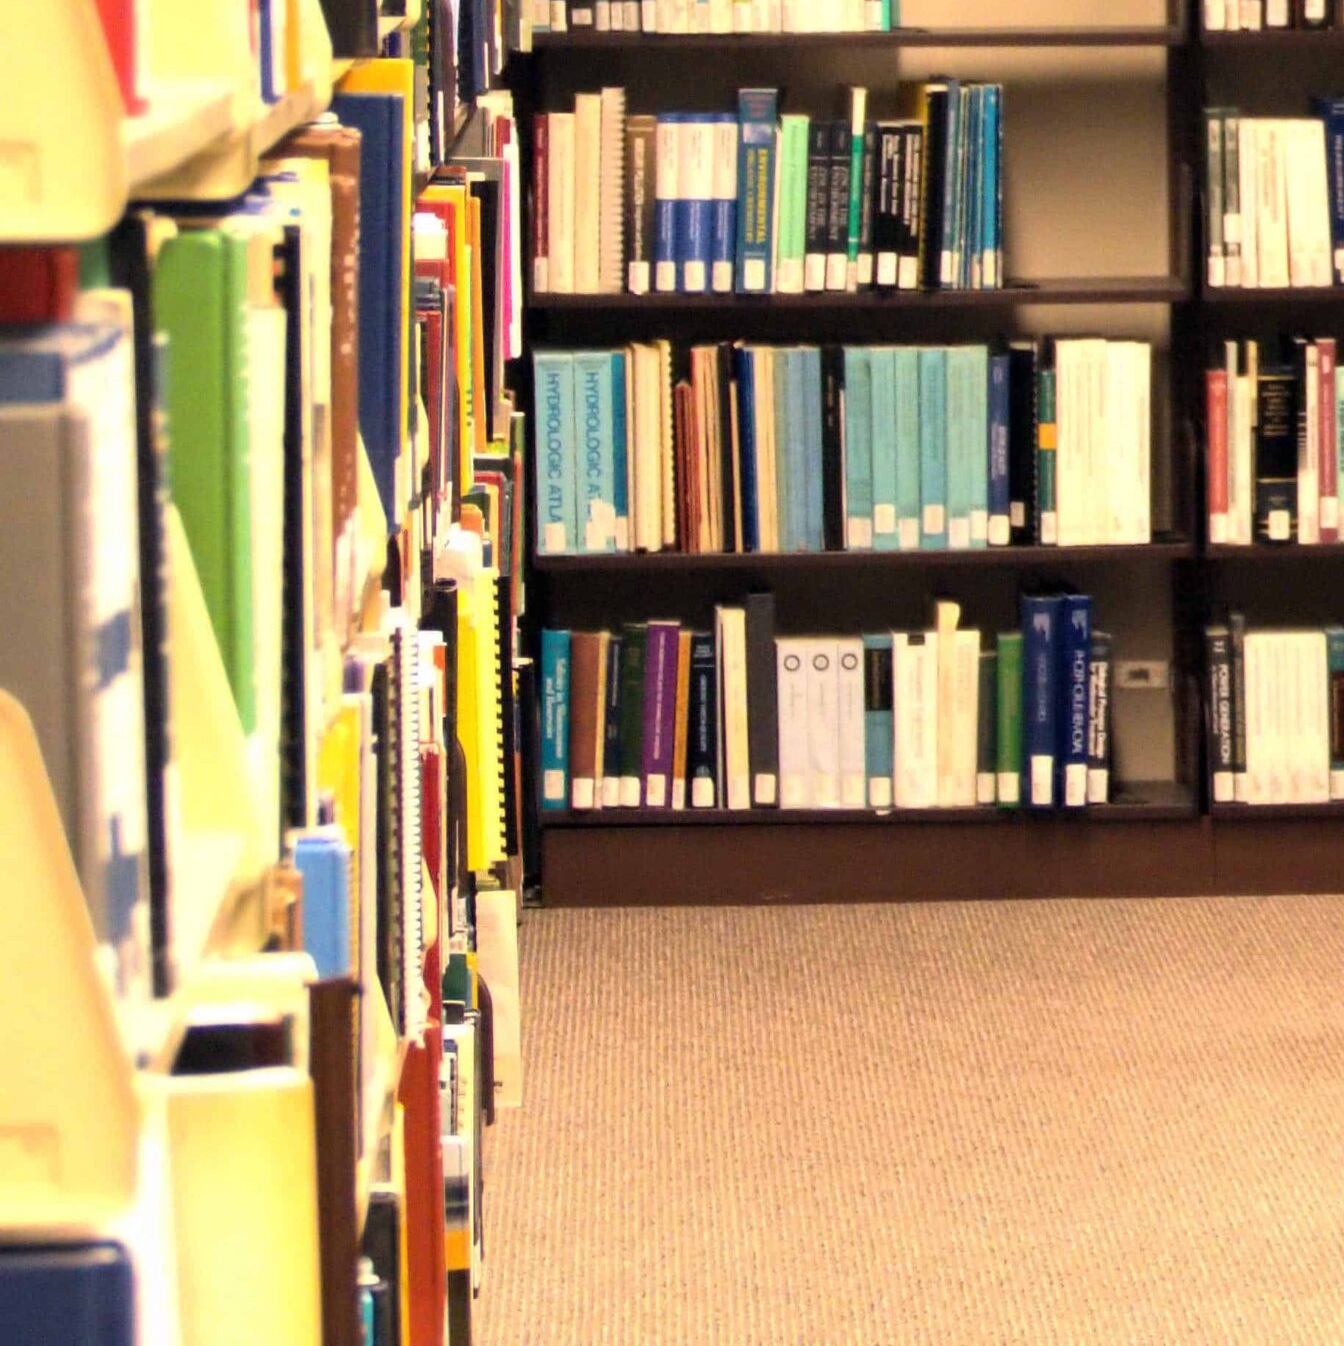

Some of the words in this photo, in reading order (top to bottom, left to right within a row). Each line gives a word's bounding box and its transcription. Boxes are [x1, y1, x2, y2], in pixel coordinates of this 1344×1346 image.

[547, 373, 561, 478] HYDROLOGIC
[586, 372, 601, 478] HYDROLOGIC
[549, 484, 562, 523] ATLA
